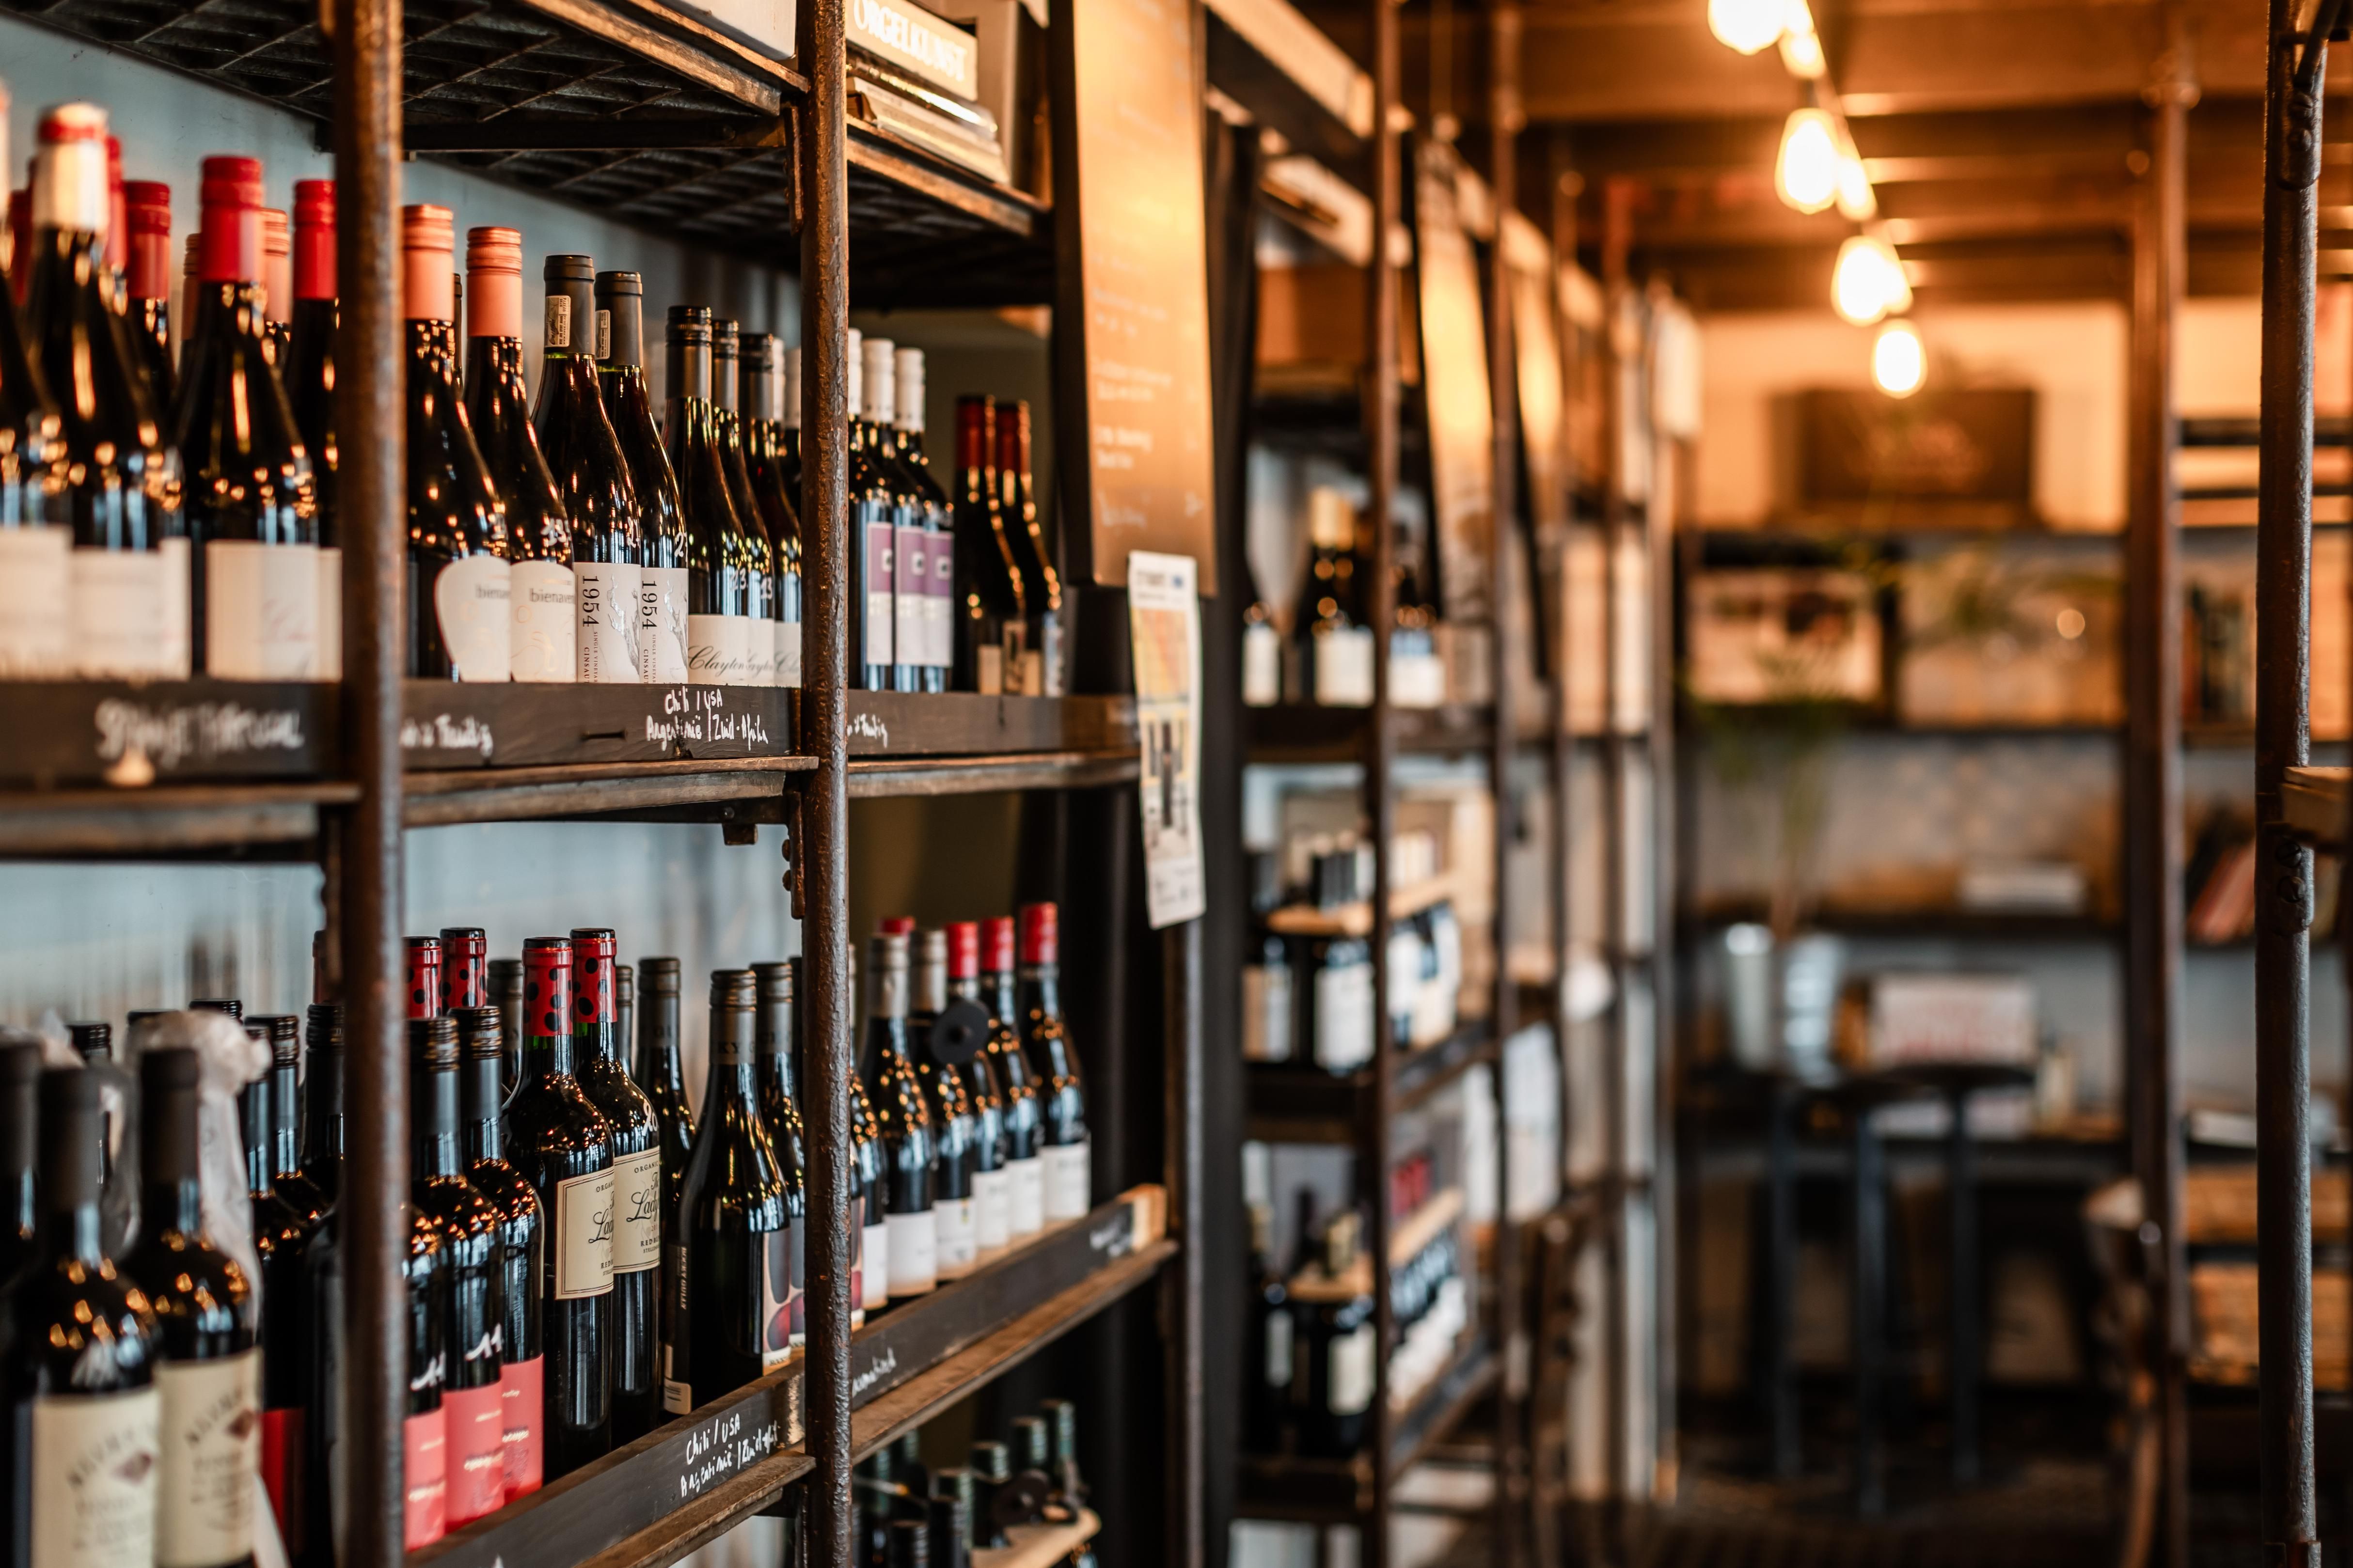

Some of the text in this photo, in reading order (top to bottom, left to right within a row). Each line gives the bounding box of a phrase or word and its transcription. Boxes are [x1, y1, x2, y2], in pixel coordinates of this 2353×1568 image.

[583, 575, 600, 627] 1954
[642, 580, 657, 630] 1954
[688, 645, 744, 677] Clayton
[704, 688, 723, 709] USA
[686, 1429, 710, 1465] Chili
[722, 1413, 740, 1443] USA
